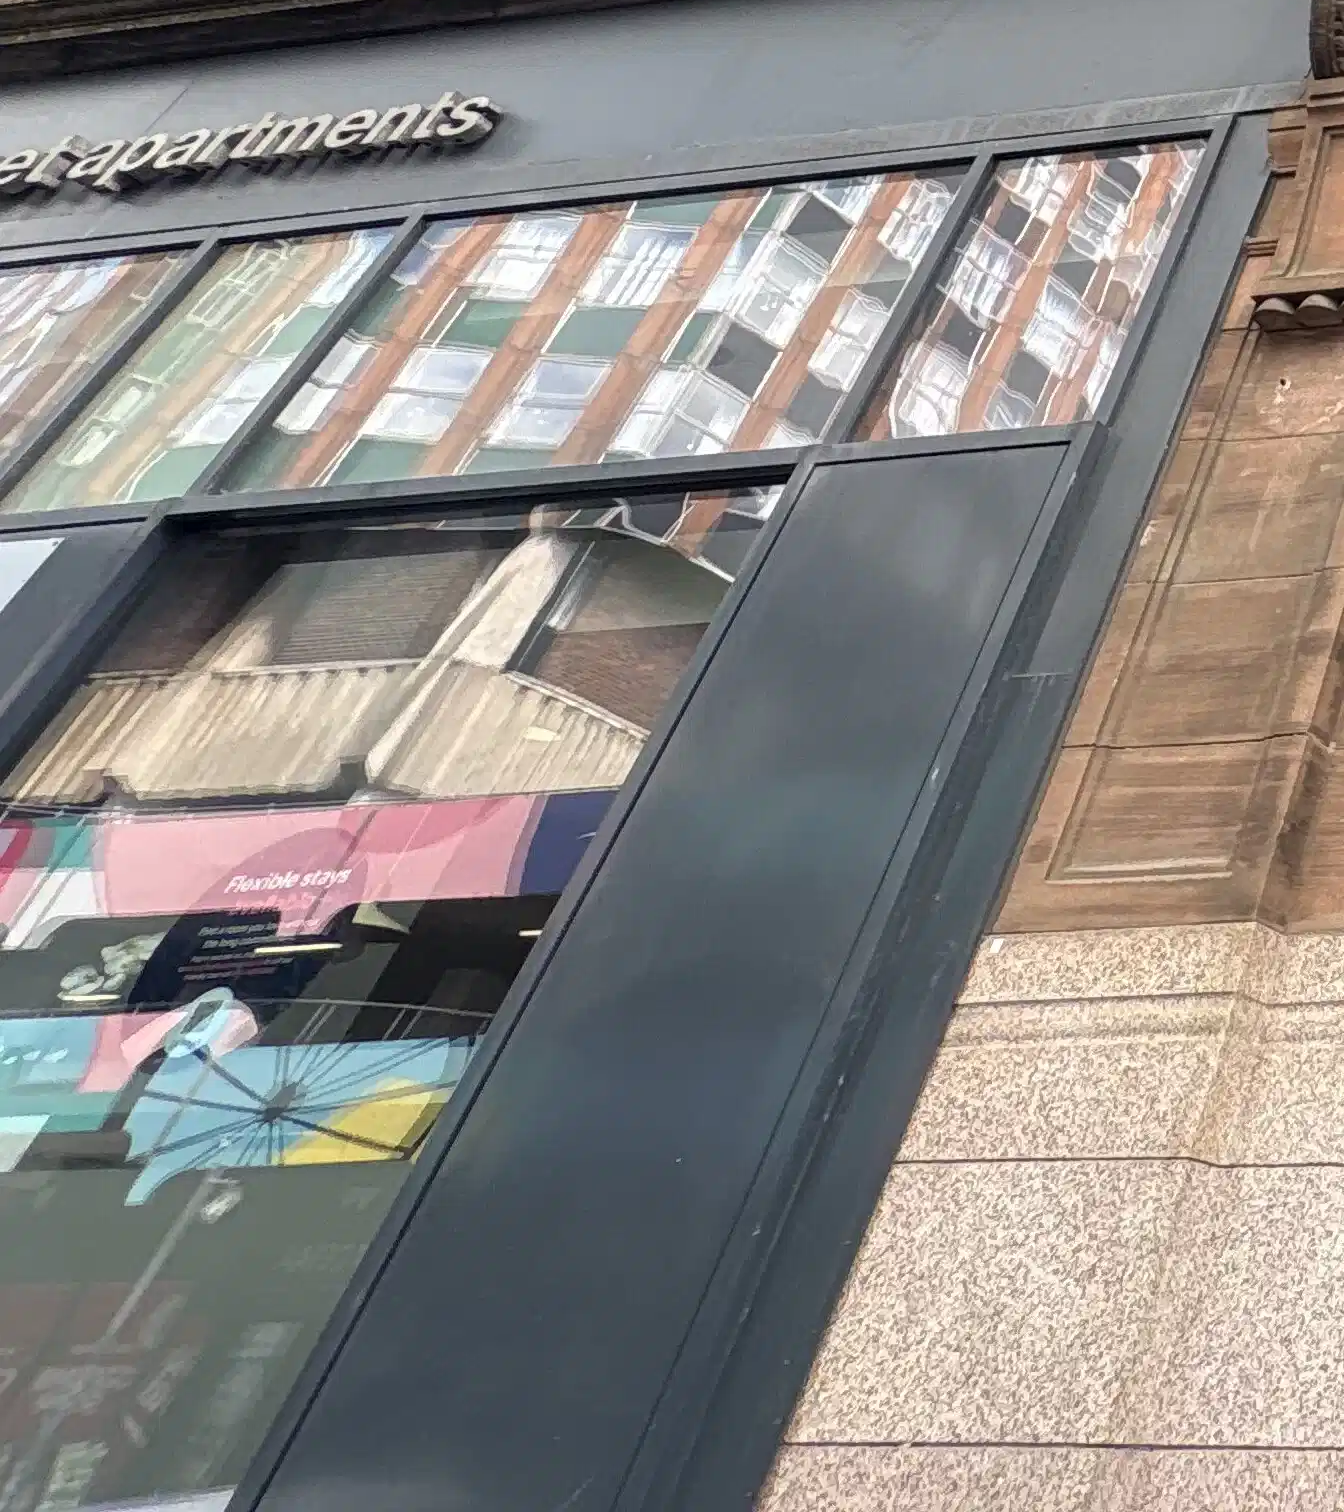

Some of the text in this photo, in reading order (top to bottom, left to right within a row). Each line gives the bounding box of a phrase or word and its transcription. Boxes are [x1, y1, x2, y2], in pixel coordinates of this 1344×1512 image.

[66, 92, 498, 192] apartments
[224, 868, 352, 894] Flexible stays
